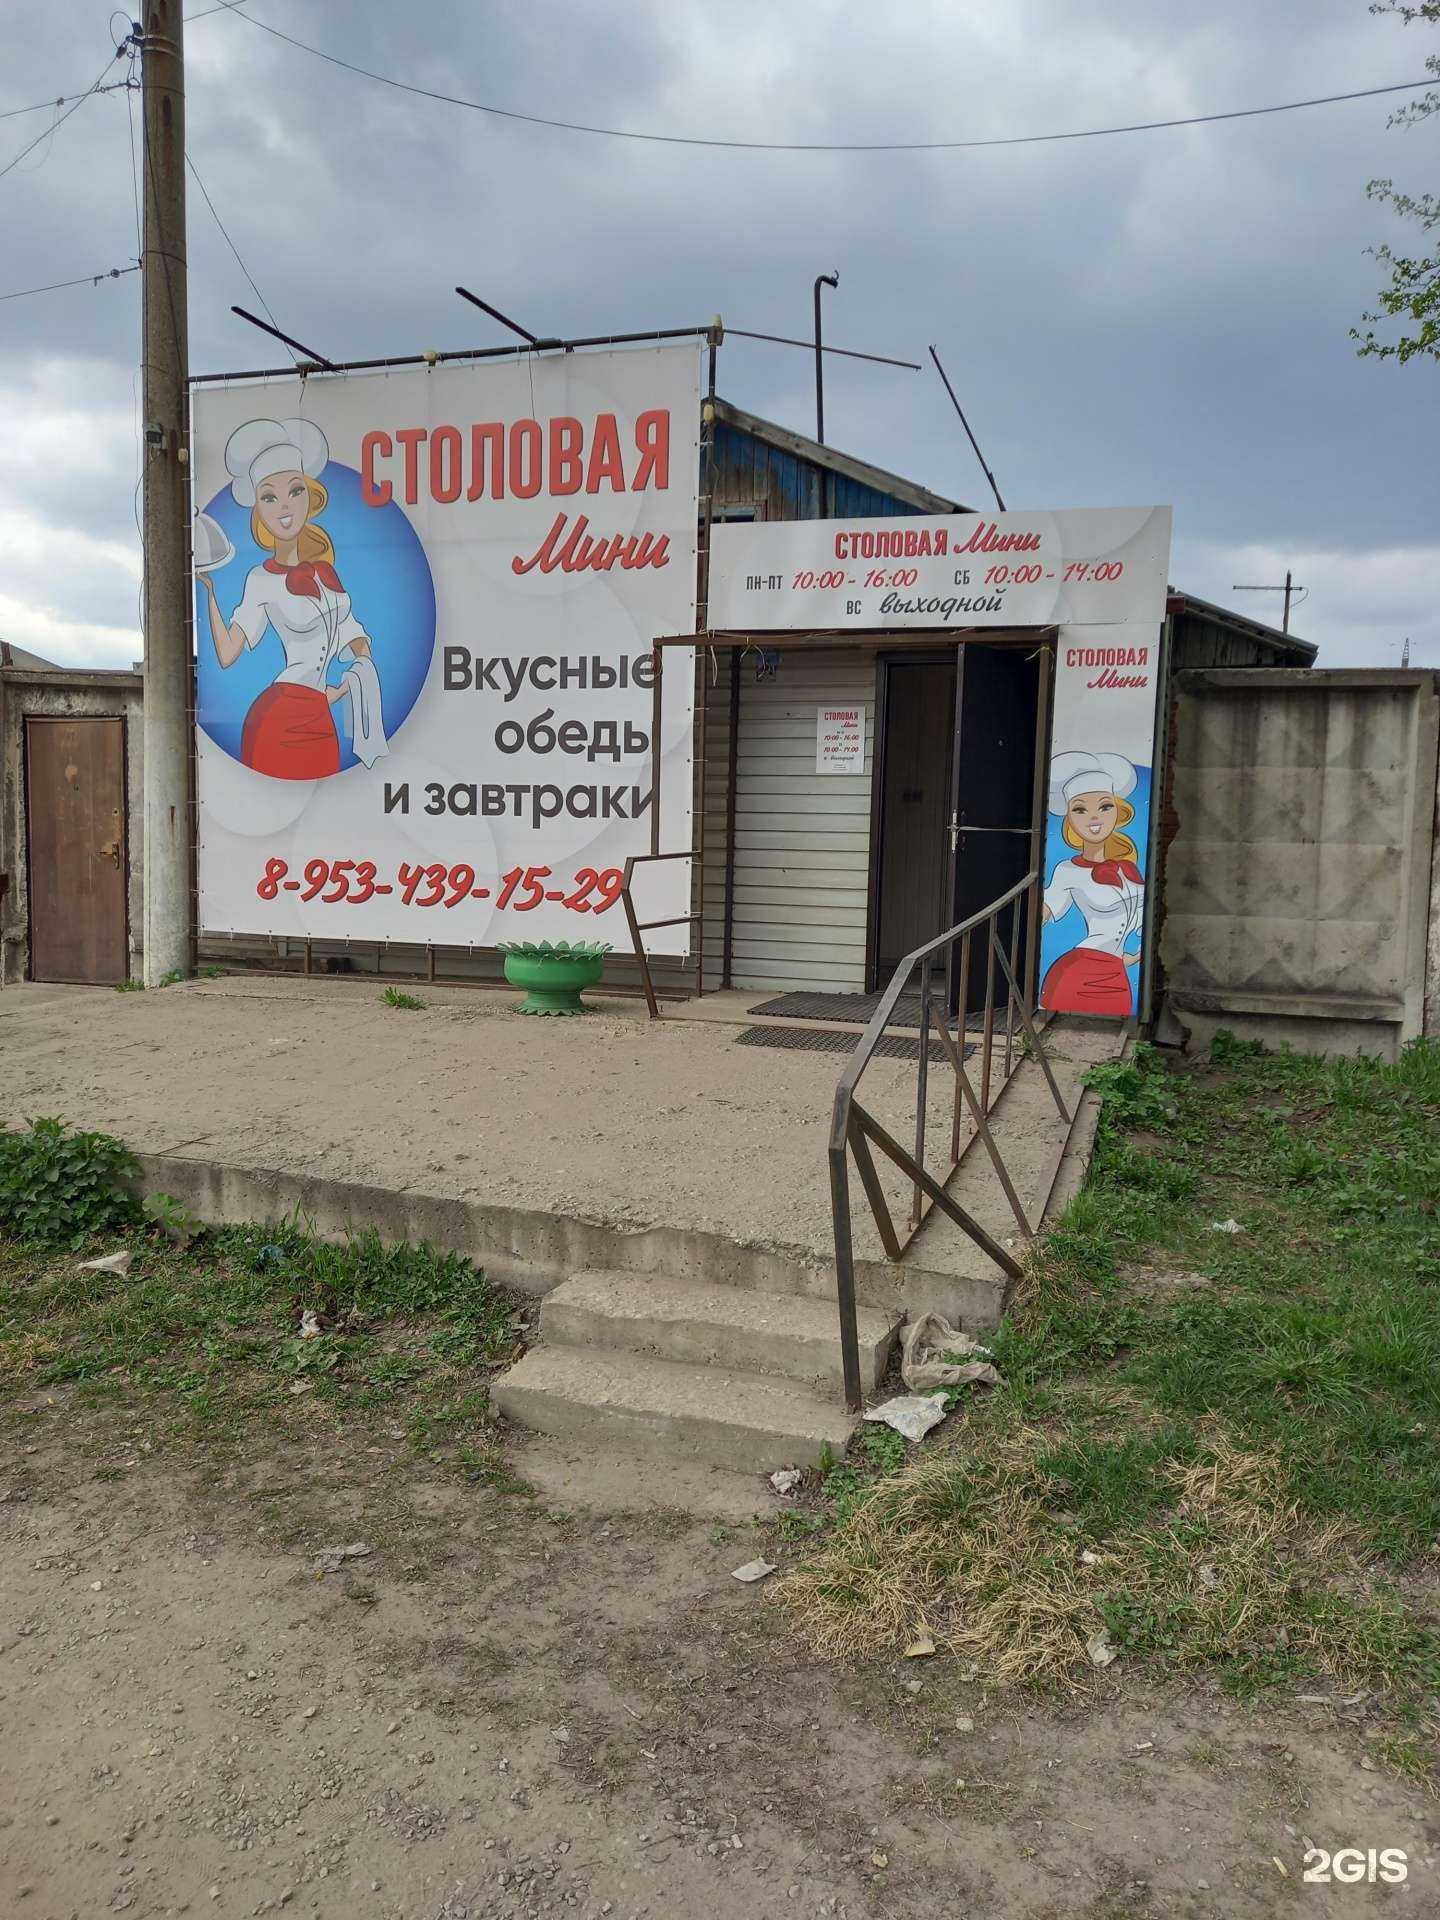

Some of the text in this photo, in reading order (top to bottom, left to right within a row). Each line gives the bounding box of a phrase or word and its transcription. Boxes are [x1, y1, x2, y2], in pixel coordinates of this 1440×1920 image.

[360, 408, 671, 508] СТОЛОВАЯ
[512, 511, 671, 576] Мини
[834, 520, 1043, 560] СТОЛОВАЯ Мини
[746, 574, 784, 591] ПН-ПТ
[791, 570, 846, 590] 10:00
[863, 568, 919, 589] 16:00
[954, 569, 971, 585] СБ
[983, 563, 1043, 585] 10:00
[1062, 560, 1124, 583] 14:00
[846, 587, 1007, 621] ВС выходной
[442, 645, 660, 702] Вкусные
[1066, 646, 1149, 668] СТОЛОВАЯ
[1086, 667, 1149, 689] Мини
[824, 711, 859, 721] СТОЛОВАЯ
[384, 781, 655, 829] и завтраки
[256, 856, 625, 916] 8-953-439-15-29
